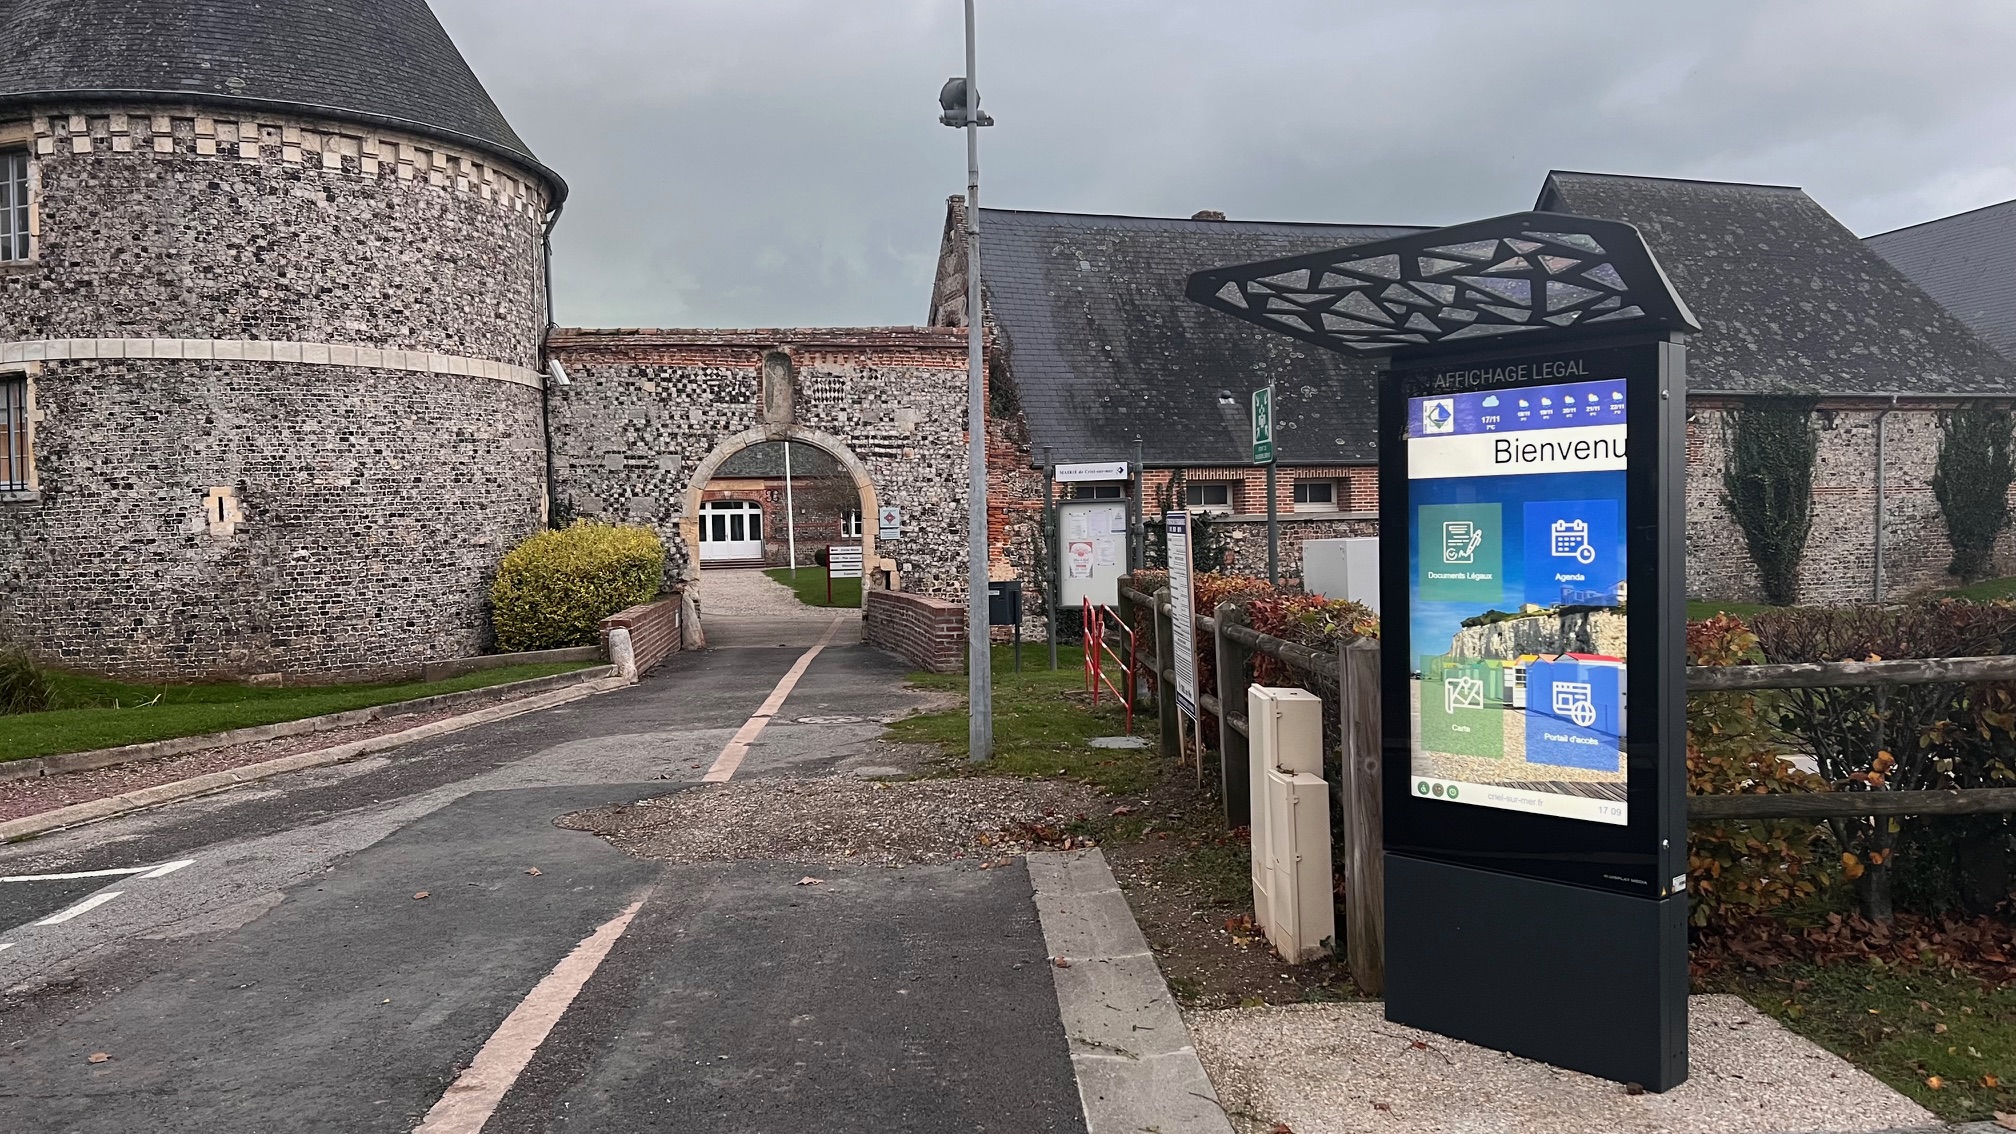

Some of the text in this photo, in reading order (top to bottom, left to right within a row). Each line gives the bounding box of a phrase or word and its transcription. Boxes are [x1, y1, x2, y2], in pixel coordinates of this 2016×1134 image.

[1435, 359, 1589, 388] AFFICHAGE LEGAL
[1481, 415, 1500, 424] 17/11
[1495, 438, 1627, 464] Bienvenu
[1428, 571, 1493, 582] Documents Légaux
[1554, 572, 1586, 583] Agenda
[1451, 724, 1471, 733] Carte
[1544, 732, 1569, 743] Portail
